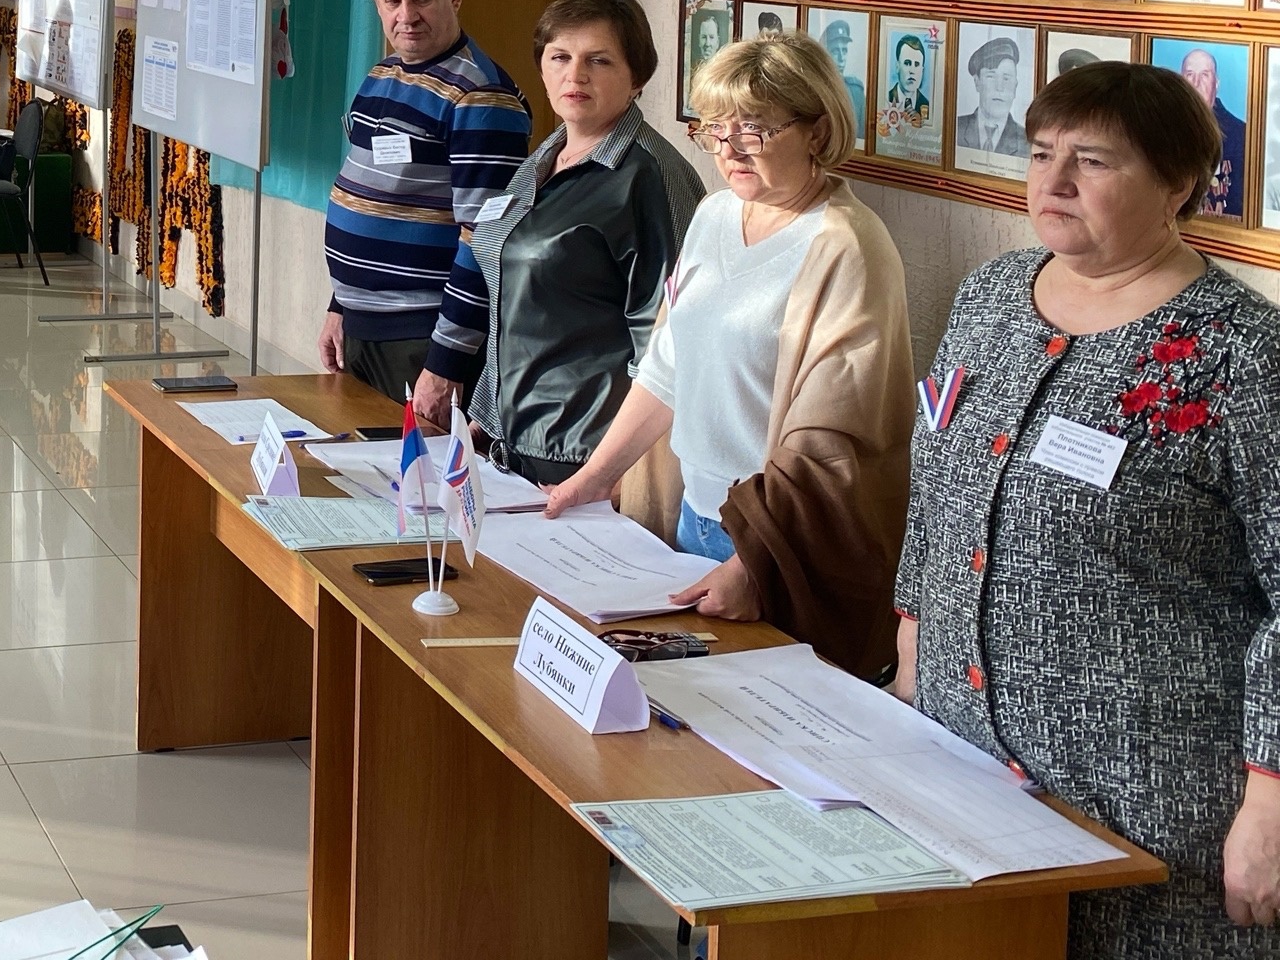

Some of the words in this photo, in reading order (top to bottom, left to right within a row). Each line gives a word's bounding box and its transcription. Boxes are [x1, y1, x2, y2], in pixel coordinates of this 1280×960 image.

[1048, 439, 1066, 451] Вера
[1067, 445, 1105, 465] Ивановна
[1057, 433, 1102, 454] Плотникова
[532, 622, 554, 644] село
[554, 634, 595, 676] Нижние
[532, 651, 576, 696] Лубянки
